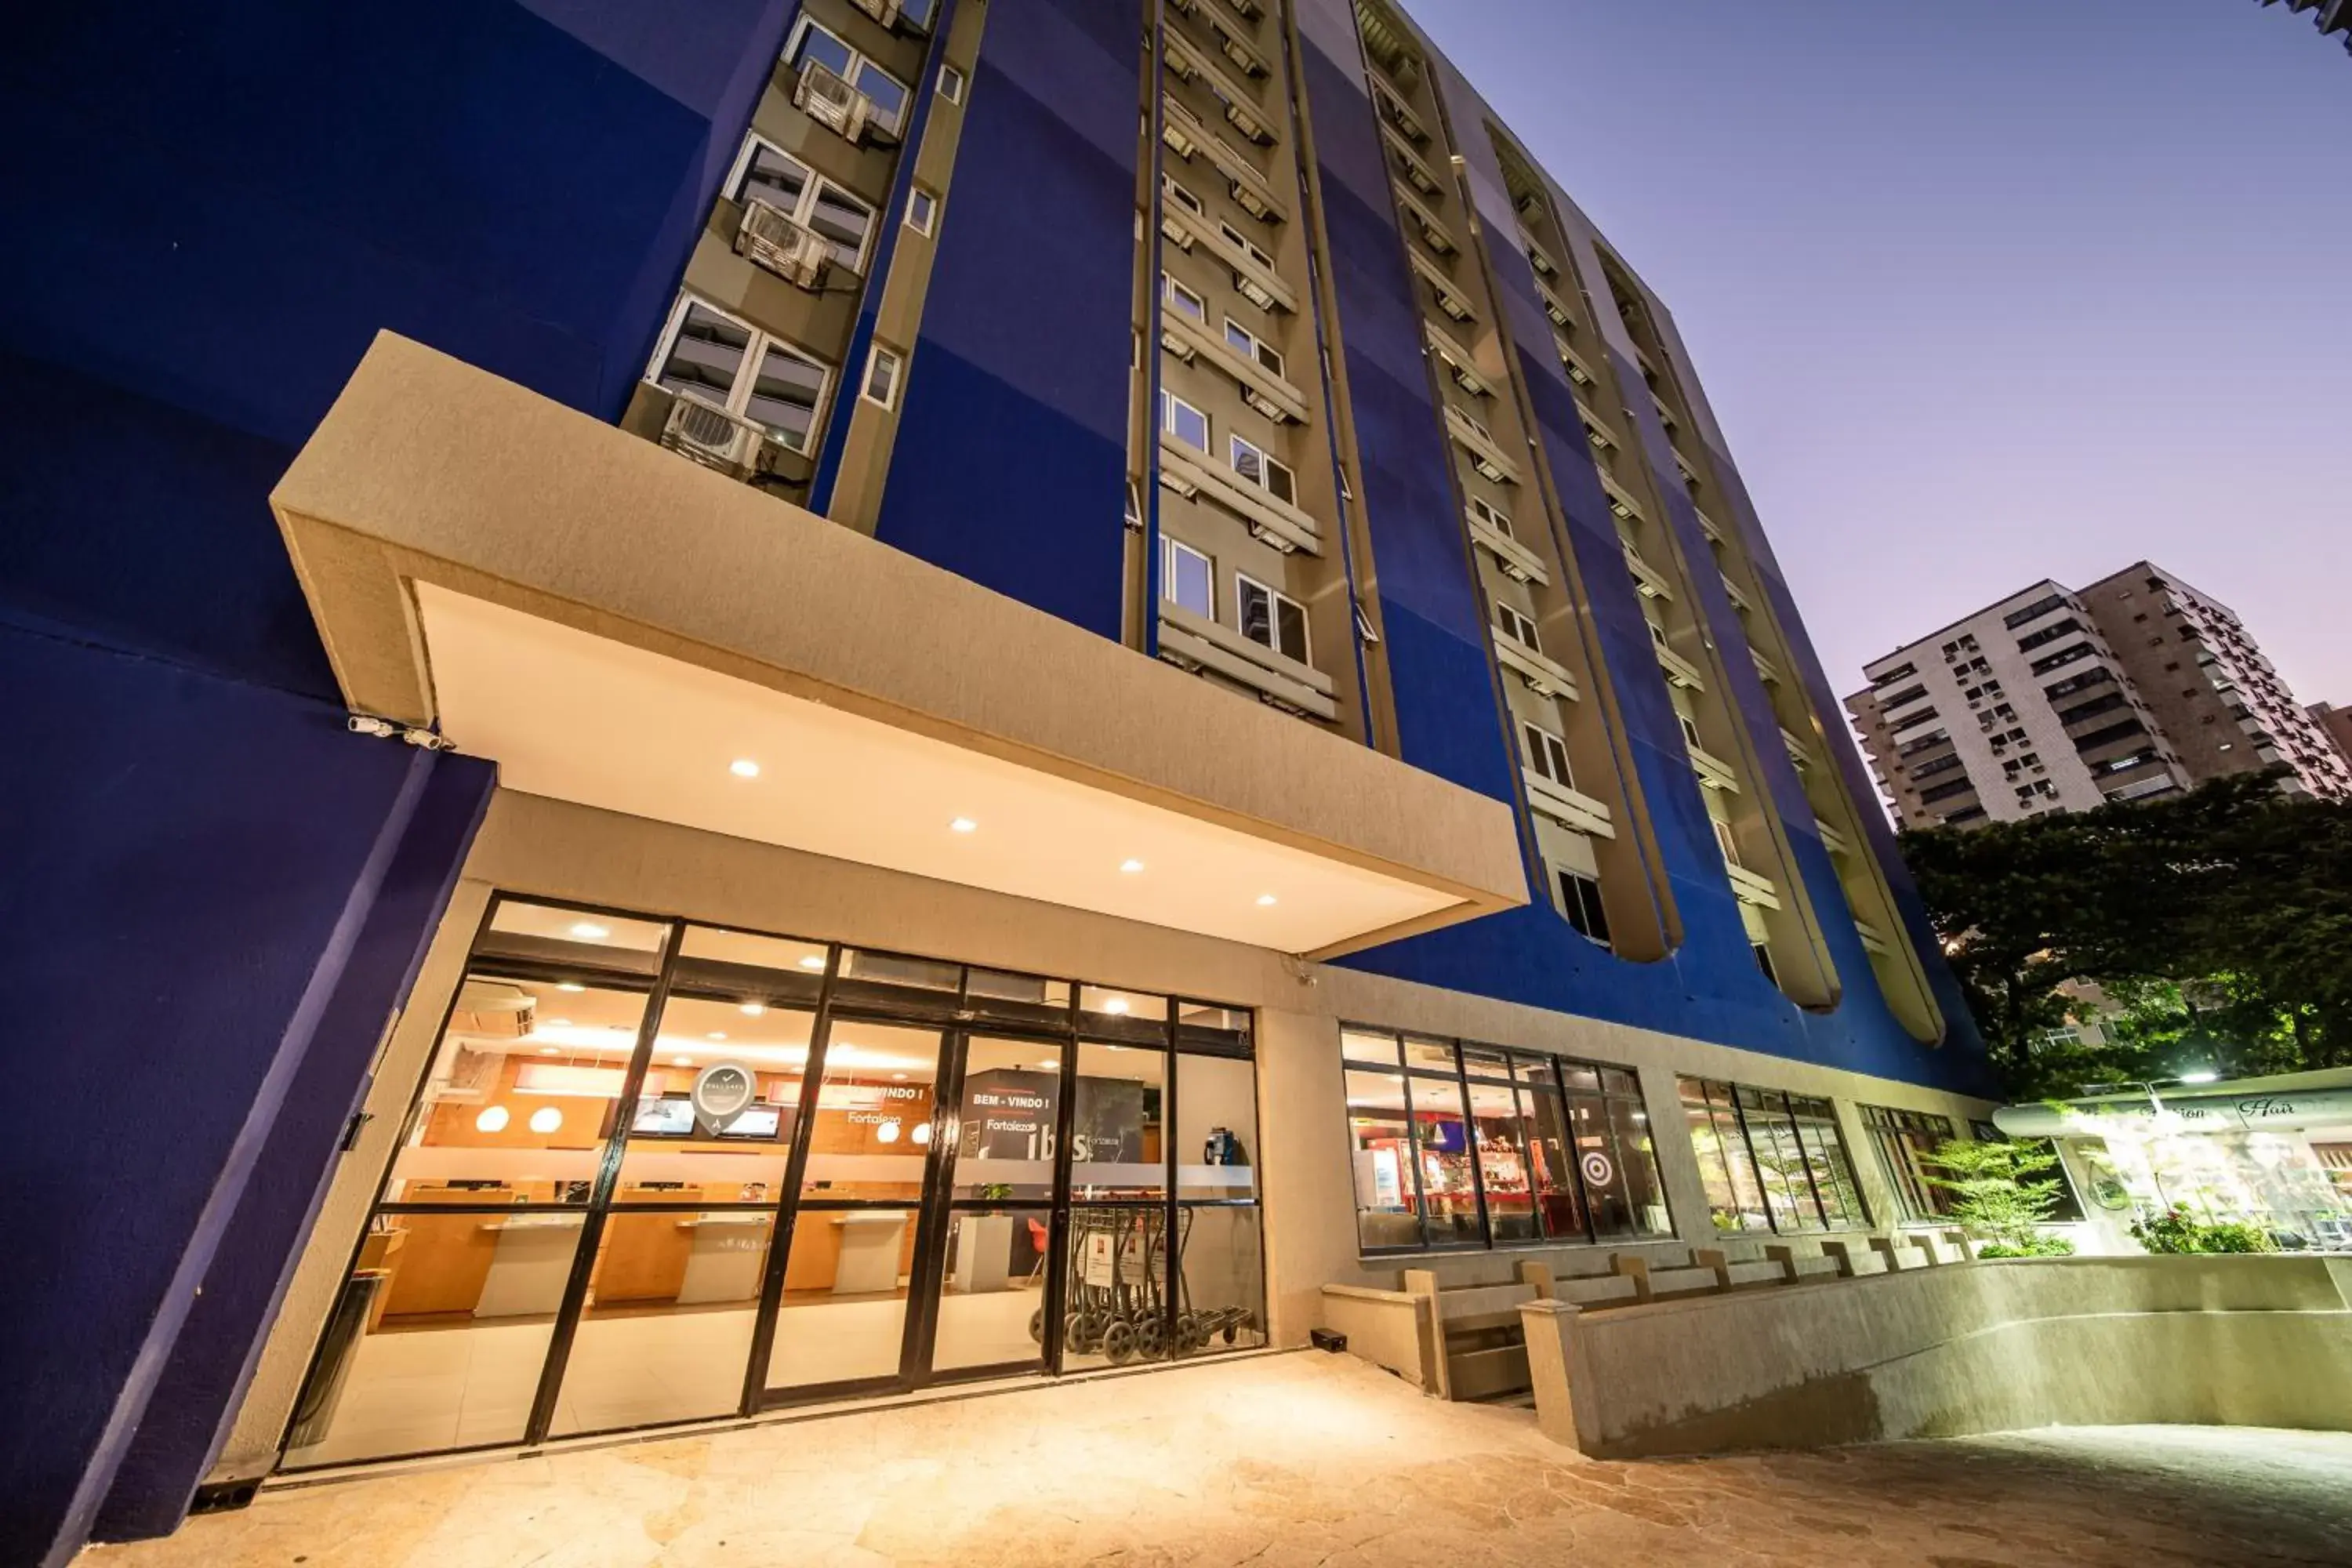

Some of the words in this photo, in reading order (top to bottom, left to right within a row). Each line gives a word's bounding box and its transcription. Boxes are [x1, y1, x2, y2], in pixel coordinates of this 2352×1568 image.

[973, 1093, 999, 1106] BEM
[1007, 1096, 1044, 1109] VINDO
[2238, 1098, 2296, 1117] Hair
[986, 1118, 1032, 1132] Fortaleza
[1027, 1123, 1088, 1161] ibs
